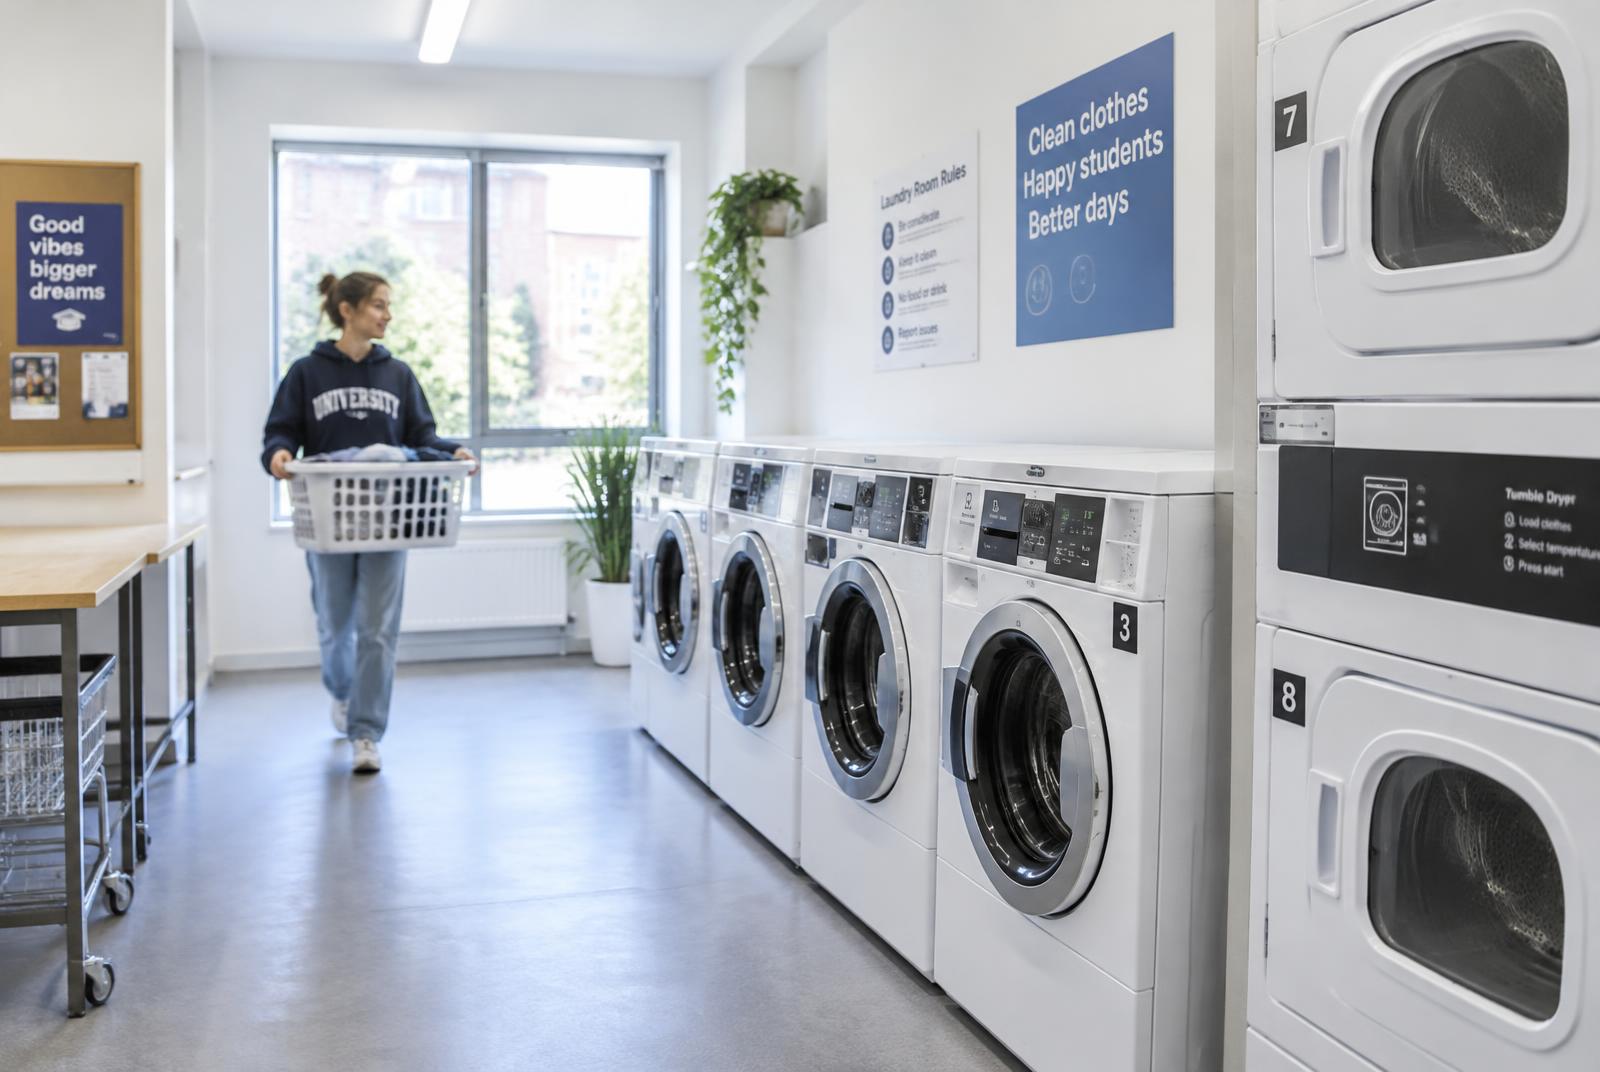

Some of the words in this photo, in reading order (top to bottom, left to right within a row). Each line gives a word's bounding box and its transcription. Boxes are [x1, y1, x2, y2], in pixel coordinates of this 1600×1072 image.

[1028, 118, 1075, 156] Clean
[1079, 86, 1148, 136] clothes
[1283, 104, 1298, 138] 7
[1023, 160, 1077, 199] Happy
[1079, 128, 1164, 179] students
[880, 186, 913, 211] Laundry
[913, 176, 939, 198] Room
[940, 164, 967, 187] Rules
[29, 213, 85, 234] Good
[1028, 202, 1081, 240] Better
[1085, 189, 1129, 226] days
[29, 236, 85, 256] vibes
[29, 259, 98, 282] bigger
[29, 281, 106, 300] dreams
[312, 387, 400, 421] UNIVERSITY
[1505, 487, 1544, 503] Tumble
[1519, 515, 1541, 529] Load
[1543, 563, 1565, 578] start
[1119, 613, 1131, 642] 3
[1281, 680, 1297, 713] 8
